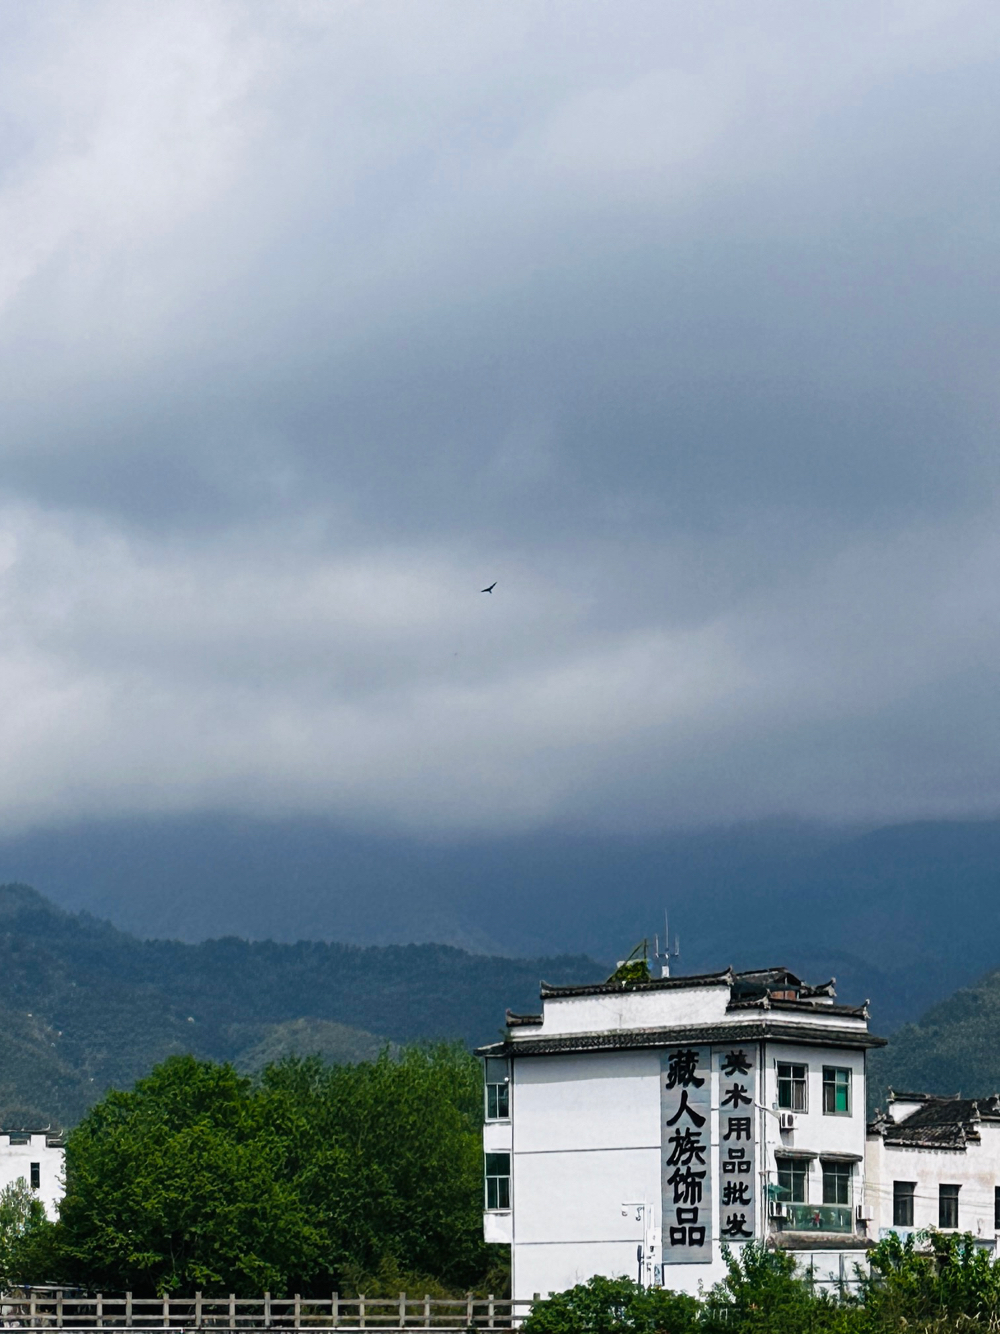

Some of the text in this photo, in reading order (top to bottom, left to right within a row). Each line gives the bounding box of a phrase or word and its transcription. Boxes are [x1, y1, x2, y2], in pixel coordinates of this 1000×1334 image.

[665, 1049, 706, 1247] 藏人族饰品
[720, 1050, 752, 1237] 美术用品批发
